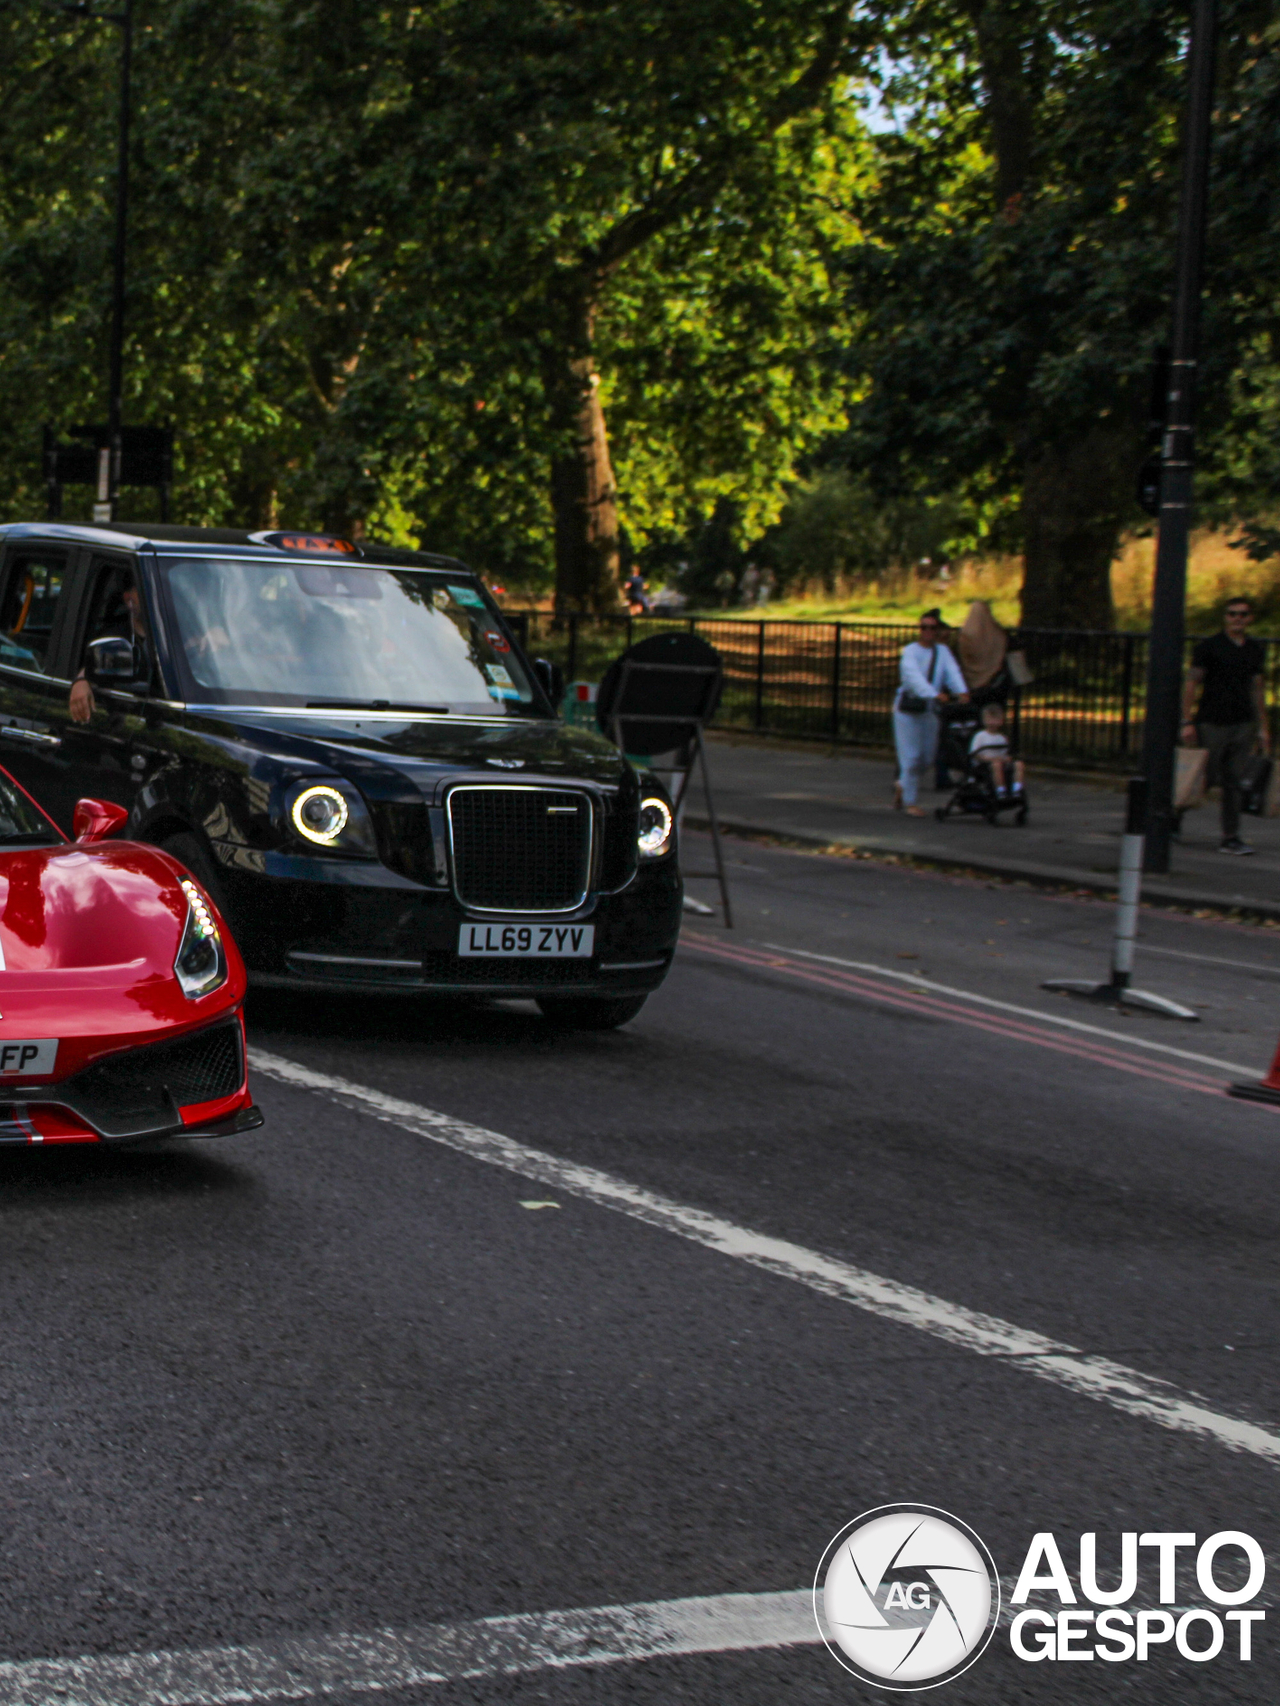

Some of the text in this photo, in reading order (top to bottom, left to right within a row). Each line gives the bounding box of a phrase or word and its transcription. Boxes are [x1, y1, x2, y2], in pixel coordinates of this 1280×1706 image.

[470, 927, 583, 952] LL69 ZYV
[0, 1045, 39, 1070] FP
